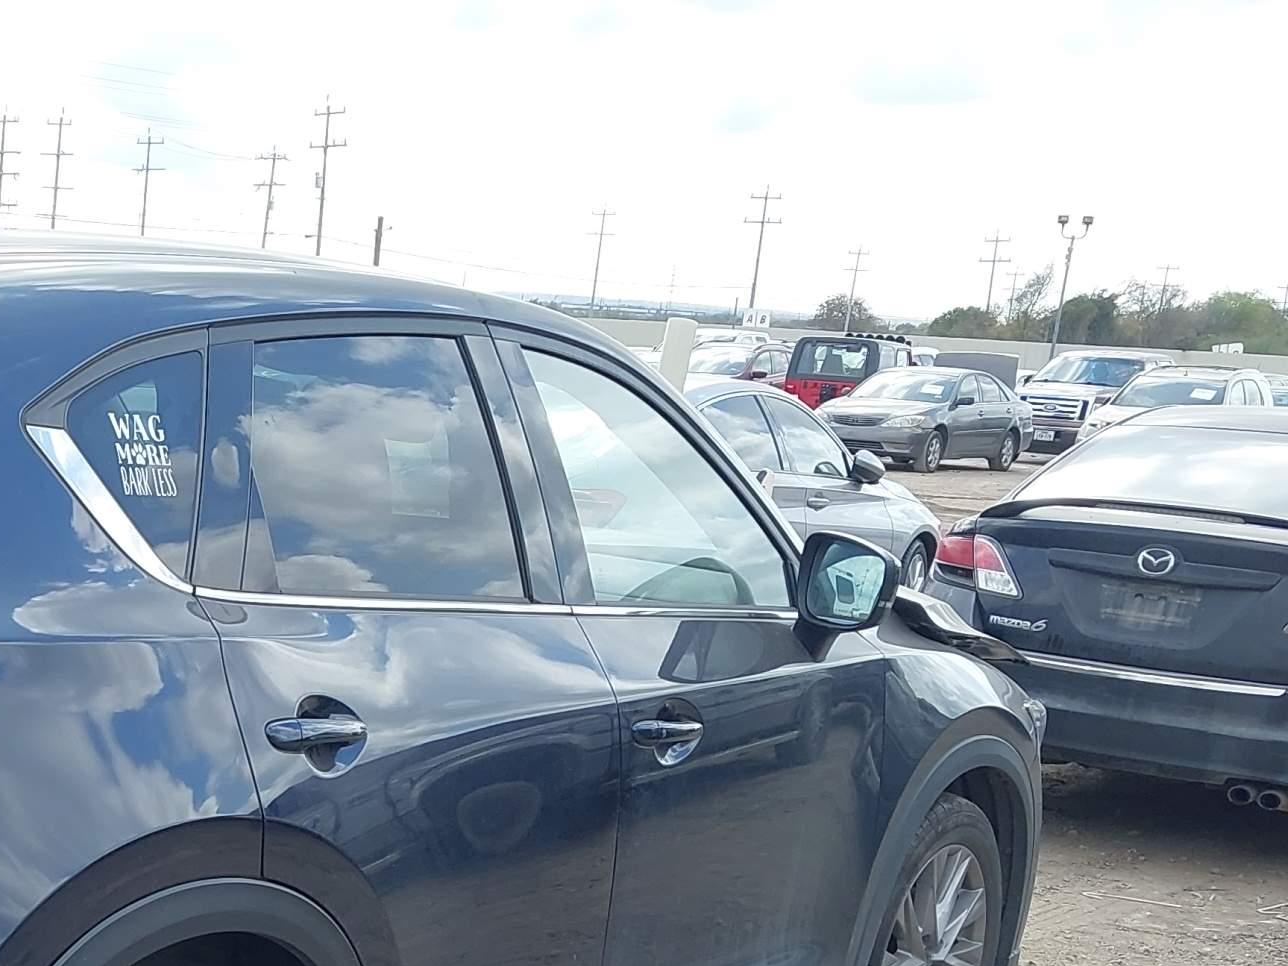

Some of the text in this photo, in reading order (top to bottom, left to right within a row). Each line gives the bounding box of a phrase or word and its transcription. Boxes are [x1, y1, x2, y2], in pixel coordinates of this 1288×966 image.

[107, 412, 165, 442] WAG
[120, 466, 178, 497] BARK LESS
